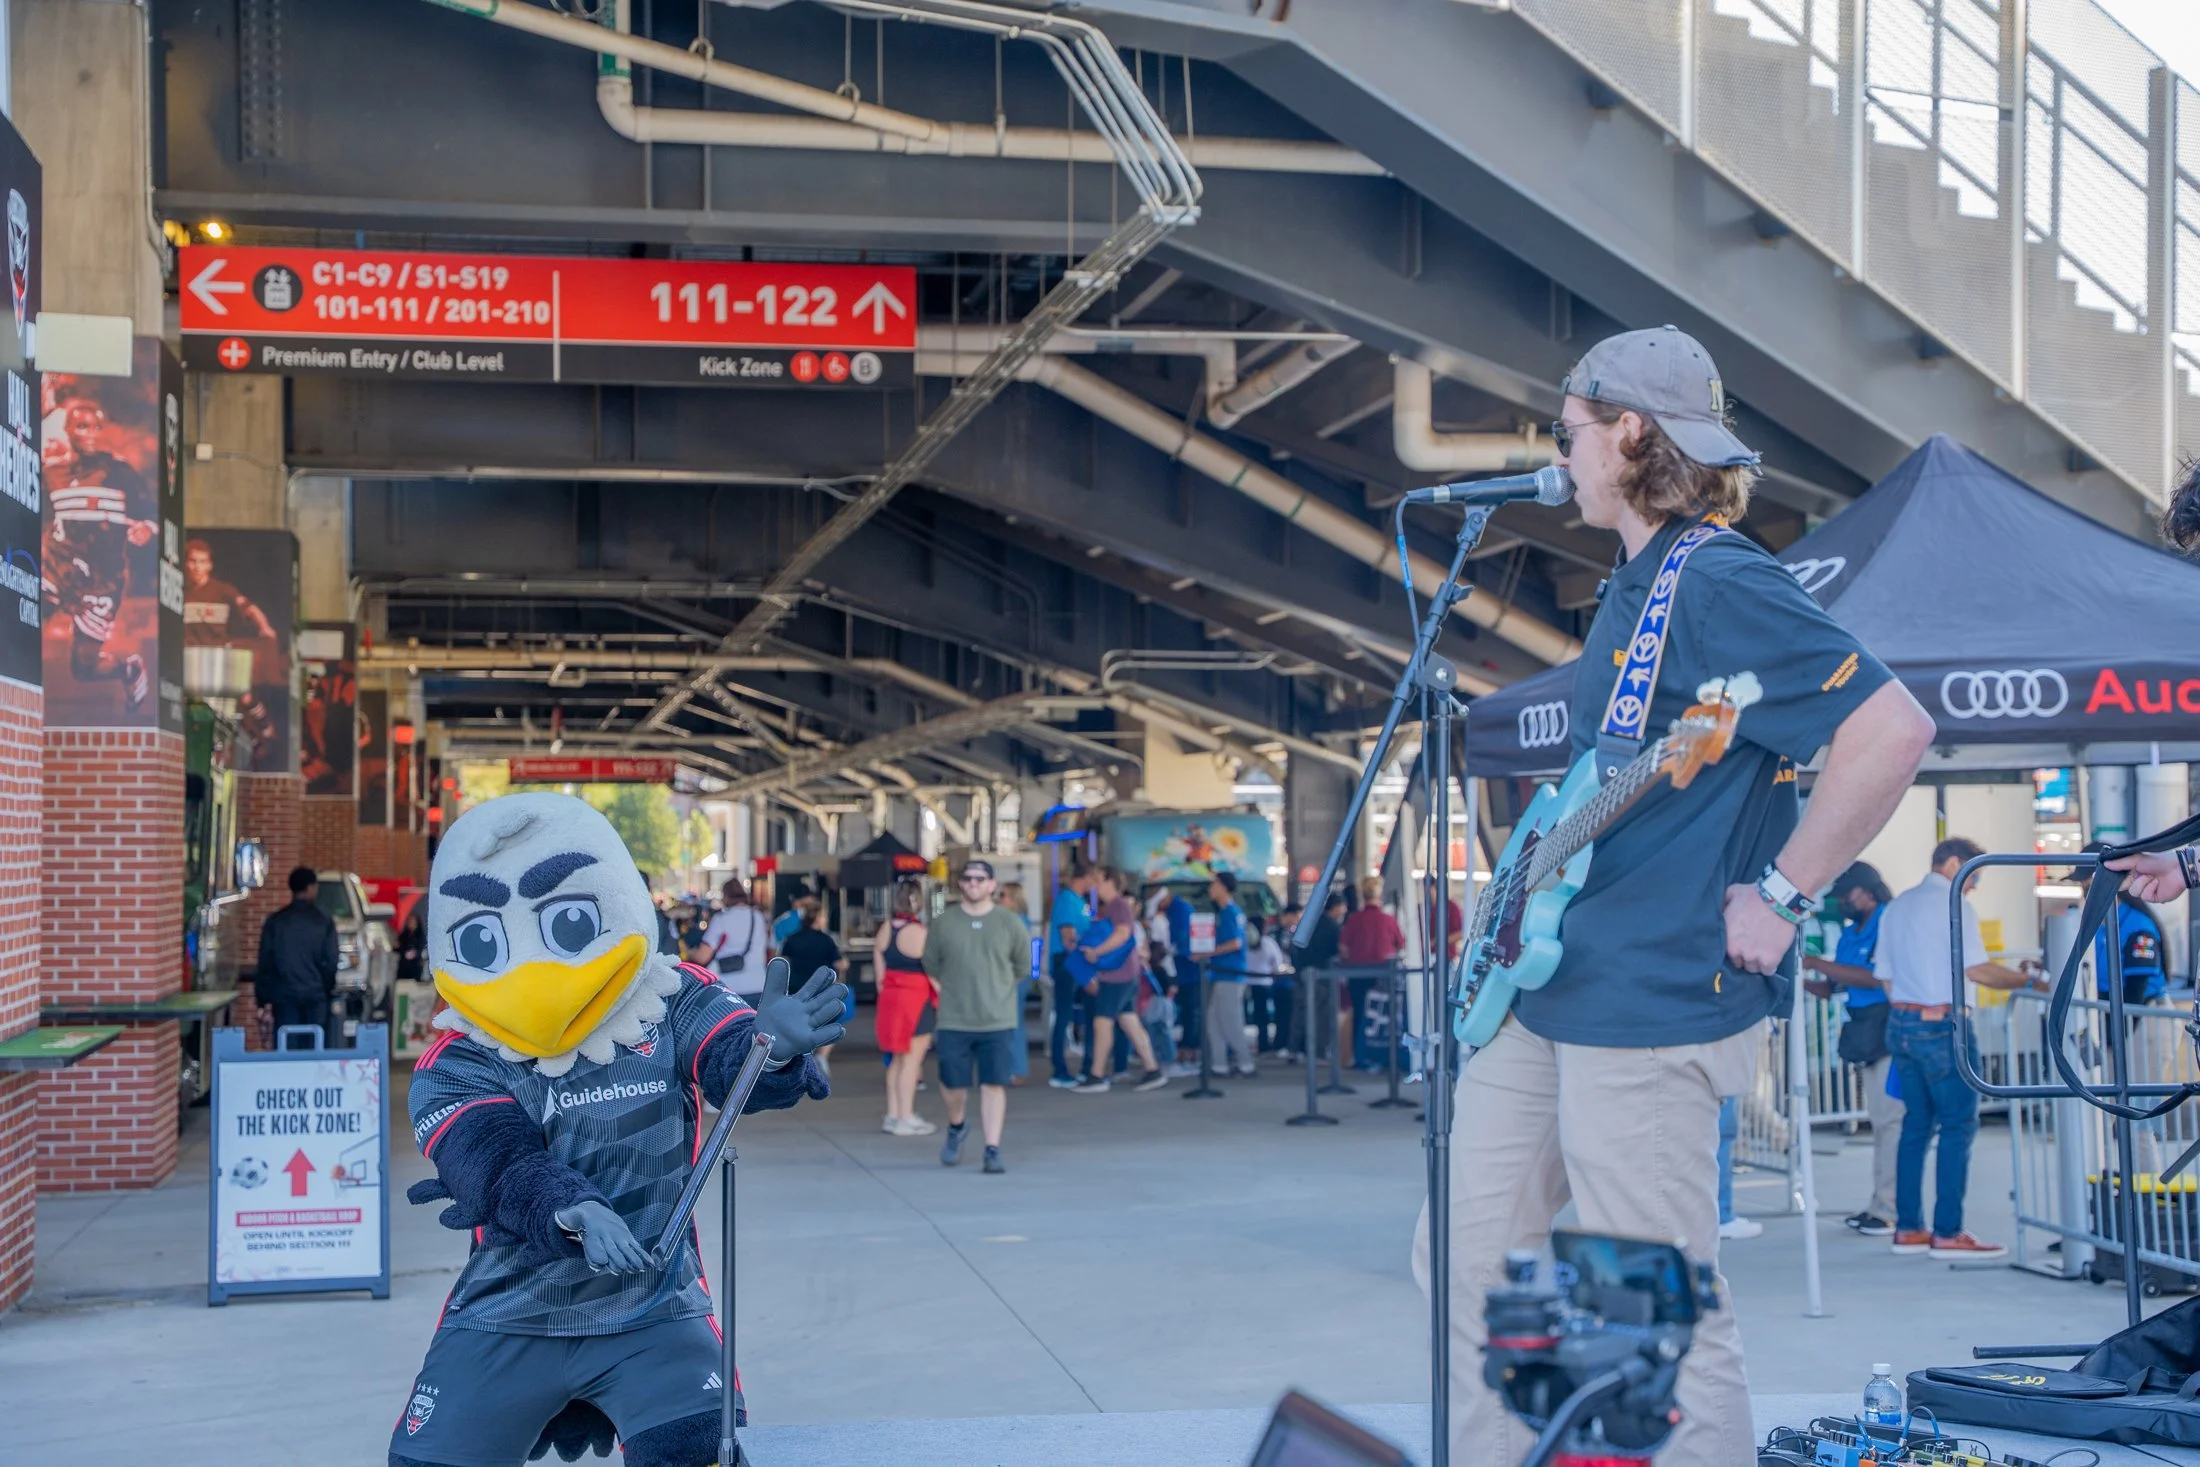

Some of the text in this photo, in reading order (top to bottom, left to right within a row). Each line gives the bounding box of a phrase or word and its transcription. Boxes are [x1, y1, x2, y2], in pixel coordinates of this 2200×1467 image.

[312, 261, 392, 286] C1-C9
[415, 265, 509, 290] S1-S19
[314, 295, 419, 322] 101-111
[444, 299, 550, 325] 201-210
[651, 281, 838, 325] 111-122
[262, 345, 346, 368] Premium
[350, 347, 397, 373] Entry
[412, 350, 453, 370] Club
[456, 350, 505, 372] Level
[700, 355, 783, 378] Kick Zone
[8, 368, 32, 440] HALL
[256, 1087, 344, 1110] CHECK OUT
[560, 1080, 667, 1108] Guidehouse
[236, 1112, 361, 1136] THE KICK ZONE!
[243, 1228, 354, 1240] OPEN UNTIL KICKOFF
[247, 1241, 287, 1252] BEHIND
[290, 1240, 335, 1250] SECTION
